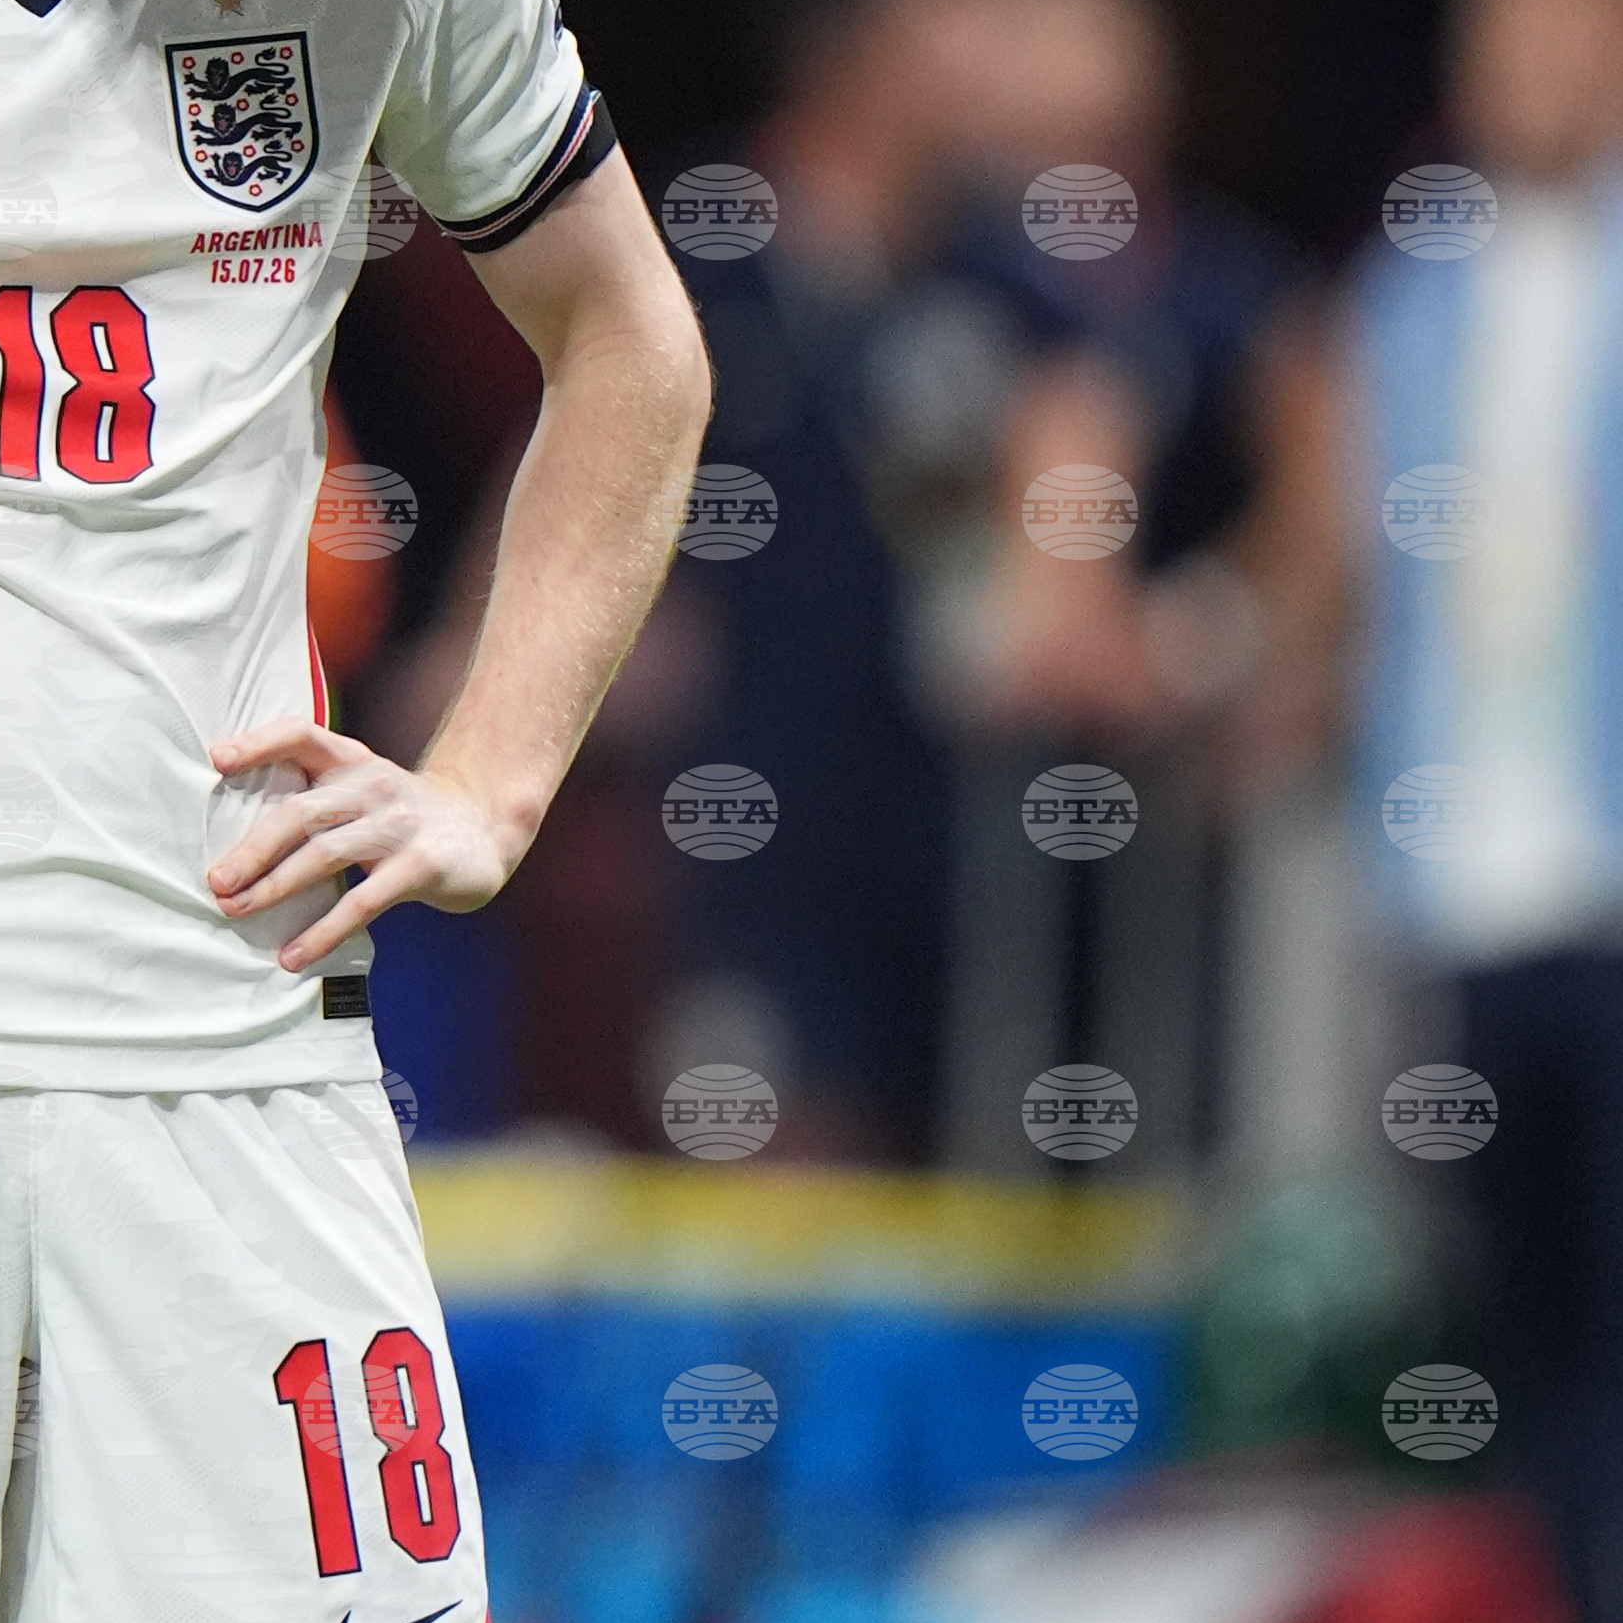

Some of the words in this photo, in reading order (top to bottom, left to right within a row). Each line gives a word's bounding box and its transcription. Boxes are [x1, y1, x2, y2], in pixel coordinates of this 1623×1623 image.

[190, 221, 323, 254] ARGENTINA
[211, 257, 295, 283] 15.07.26
[273, 1326, 461, 1578] 18
